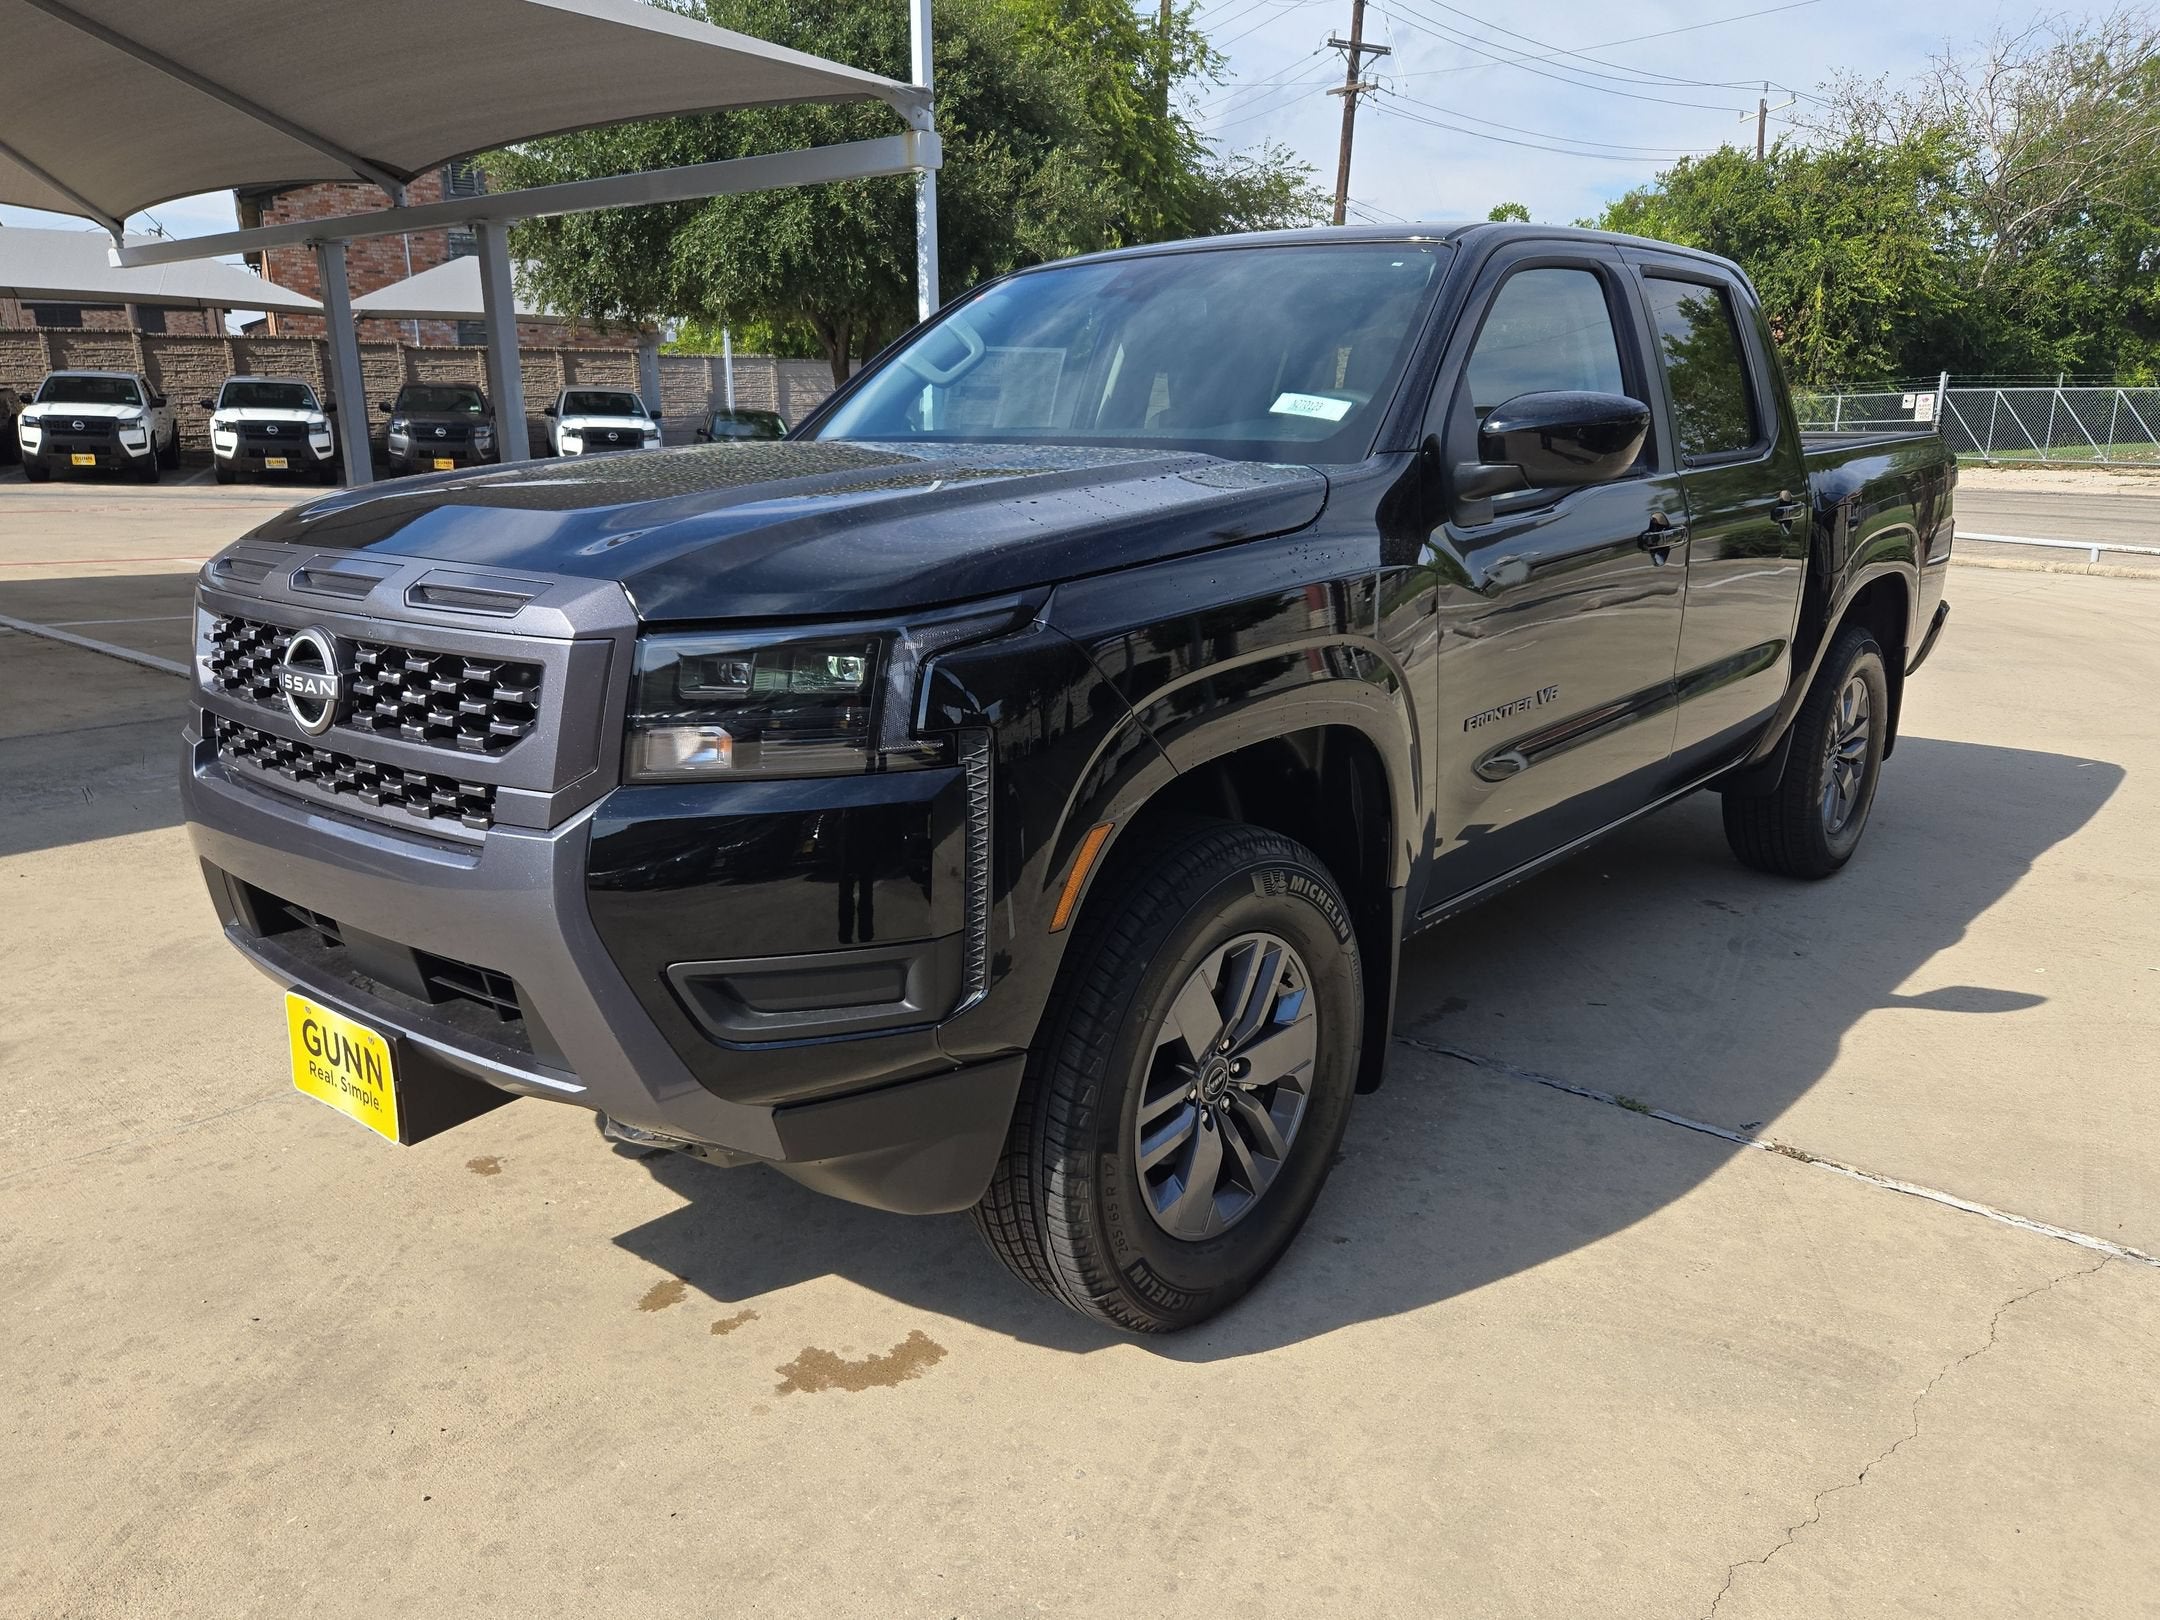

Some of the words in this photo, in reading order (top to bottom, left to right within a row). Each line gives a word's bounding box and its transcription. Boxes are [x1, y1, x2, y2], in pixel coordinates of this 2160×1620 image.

[1464, 696, 1533, 733] FRONTIER
[1536, 684, 1559, 705] V6
[1289, 874, 1349, 939] MICHELIN
[302, 1018, 383, 1092] GUNN
[309, 1060, 338, 1088] Real.
[341, 1076, 383, 1113] Simple.
